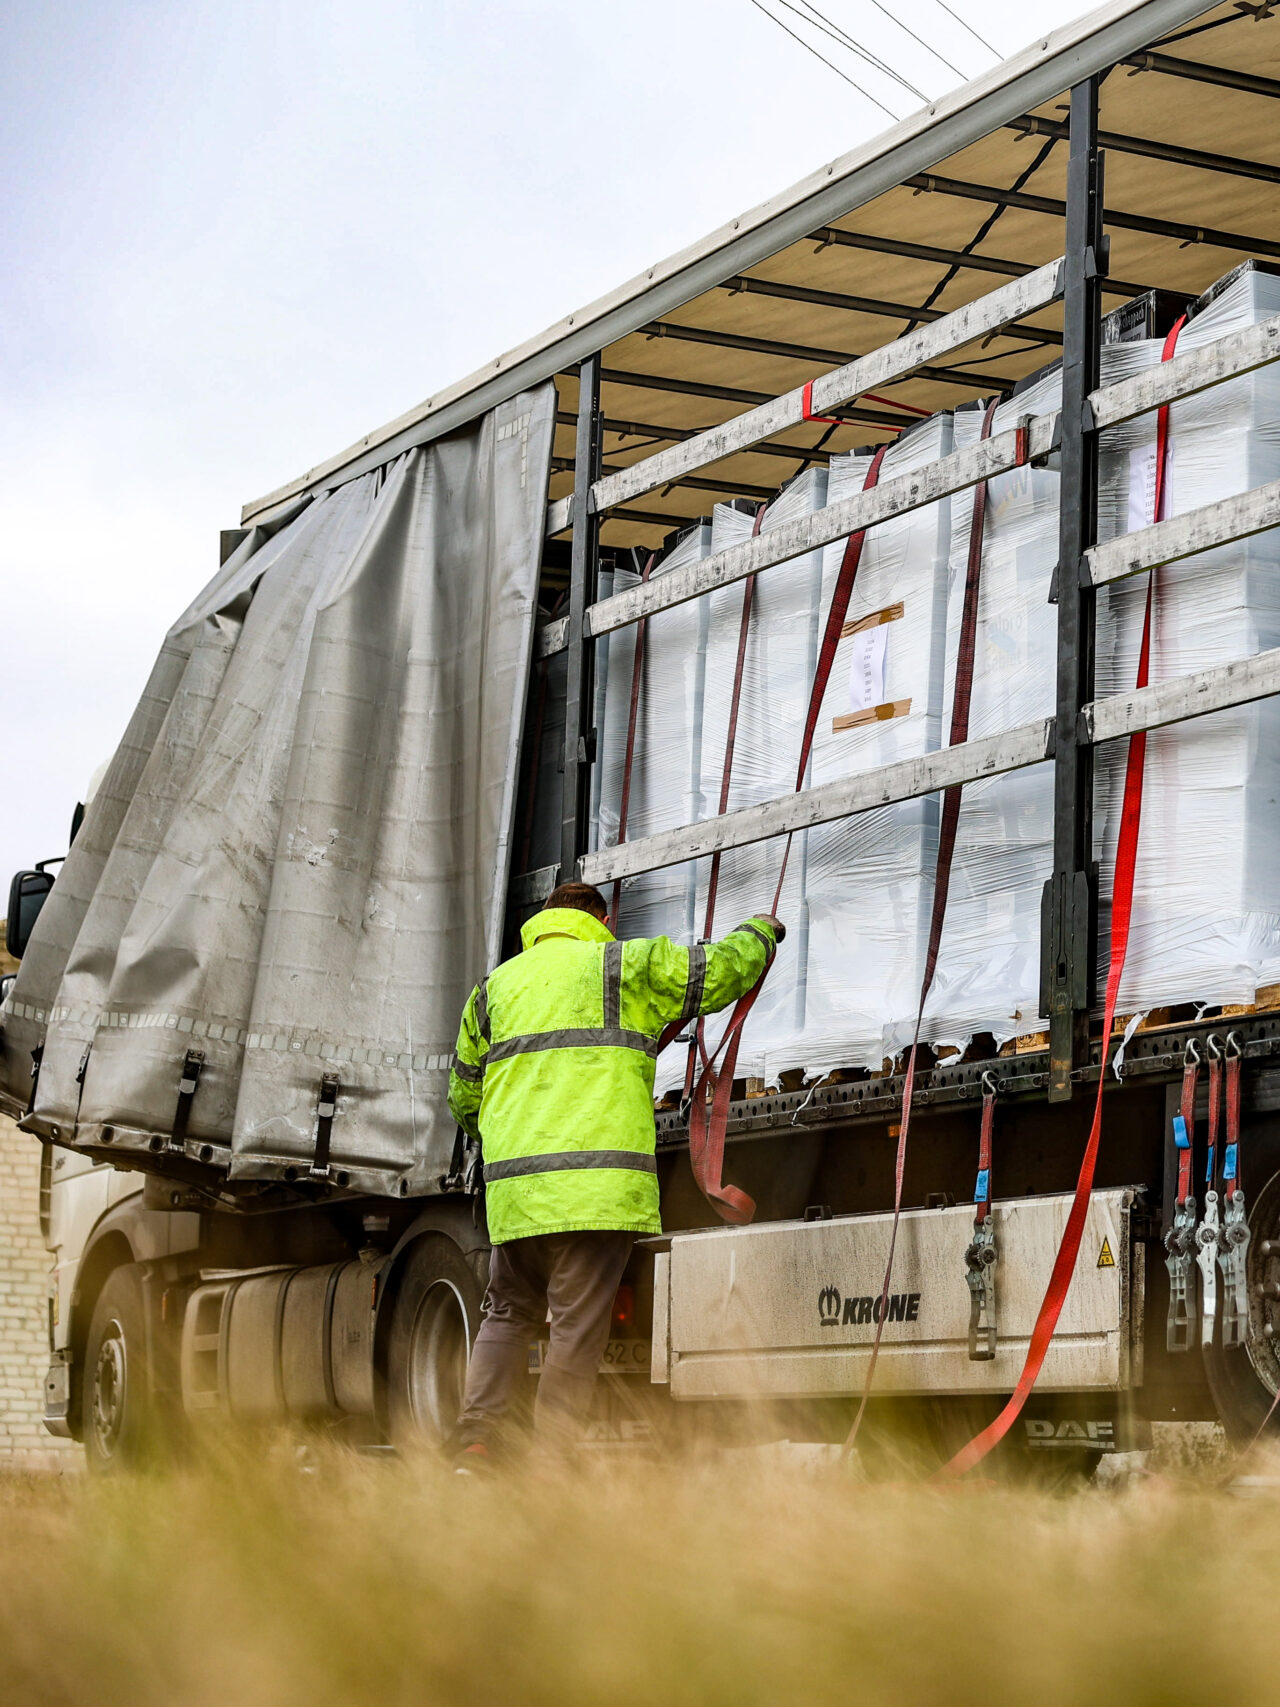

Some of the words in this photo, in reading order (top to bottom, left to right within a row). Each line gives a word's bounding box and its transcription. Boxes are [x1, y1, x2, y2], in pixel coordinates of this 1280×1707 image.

[842, 1293, 921, 1325] KRONE
[603, 1342, 628, 1364] 62
[631, 1343, 648, 1364] C
[583, 1420, 650, 1440] AF
[1024, 1419, 1114, 1439] DAF
